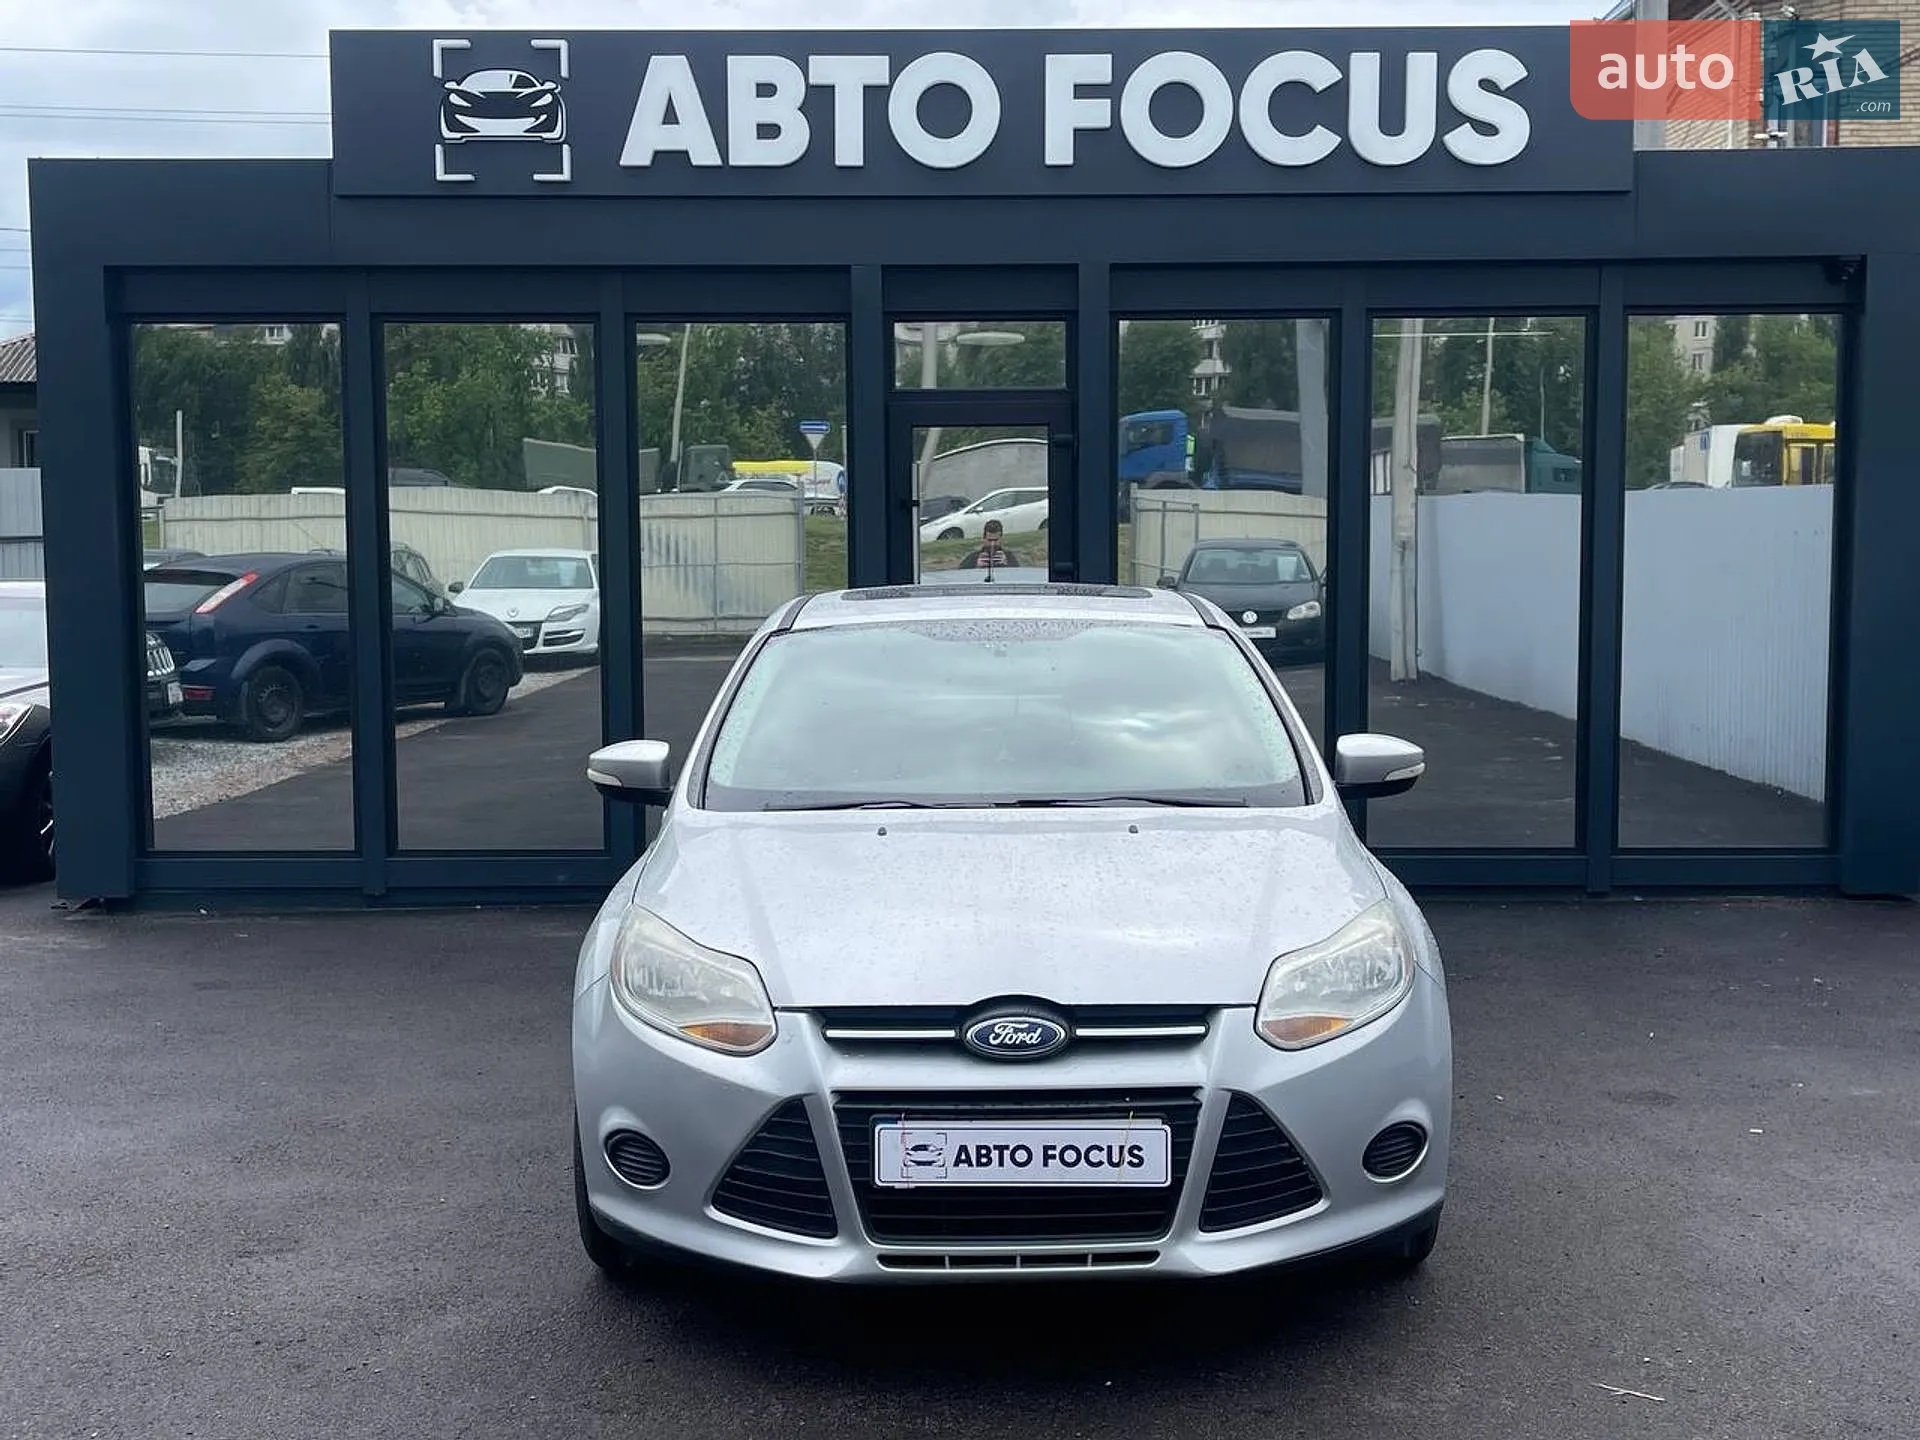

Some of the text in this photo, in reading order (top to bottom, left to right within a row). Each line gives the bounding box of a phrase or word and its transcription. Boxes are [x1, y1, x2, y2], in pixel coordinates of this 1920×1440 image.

[619, 48, 1532, 169] АВТО FOCUS
[989, 1022, 1042, 1045] Ford
[953, 1144, 1145, 1168] АВТО FOCUS
